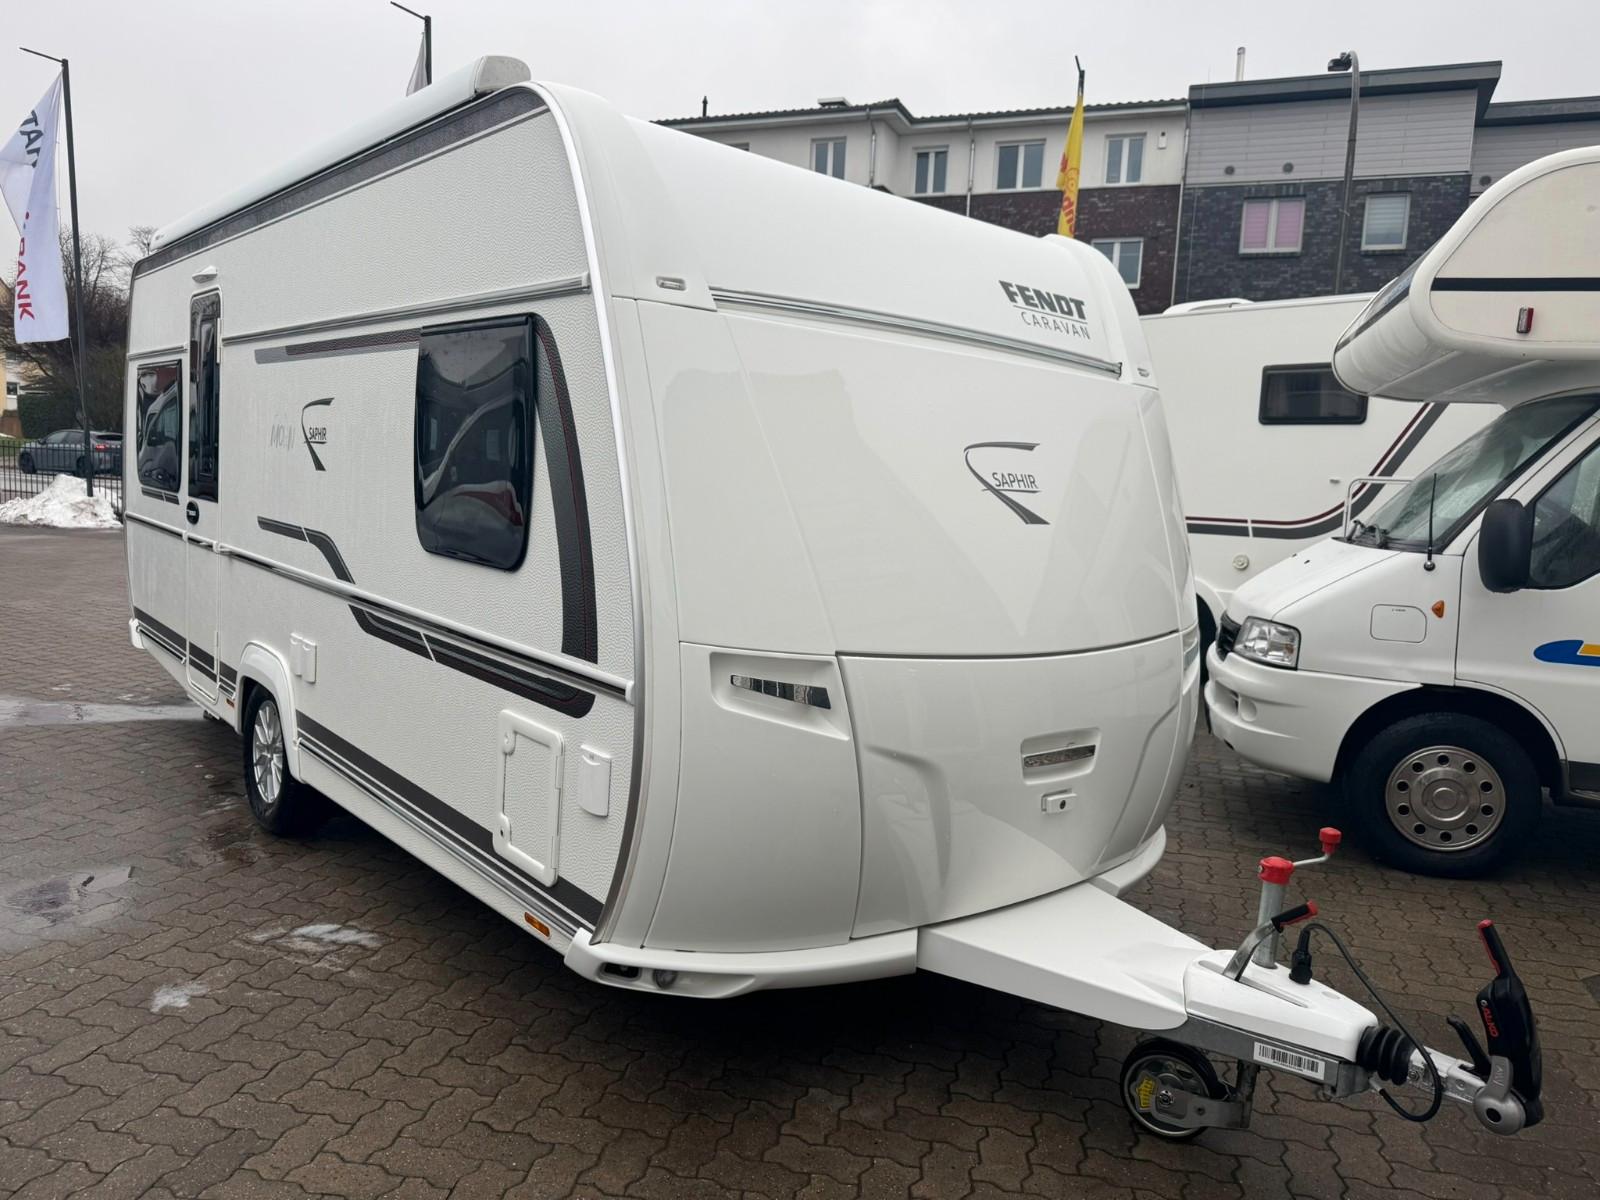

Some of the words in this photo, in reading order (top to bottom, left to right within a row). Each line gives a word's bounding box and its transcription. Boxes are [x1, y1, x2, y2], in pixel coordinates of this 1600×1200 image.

[998, 279, 1087, 321] FENDT
[1020, 311, 1091, 340] CARAVAN
[308, 426, 328, 442] SAPHIR
[991, 471, 1040, 490] SAPHIR
